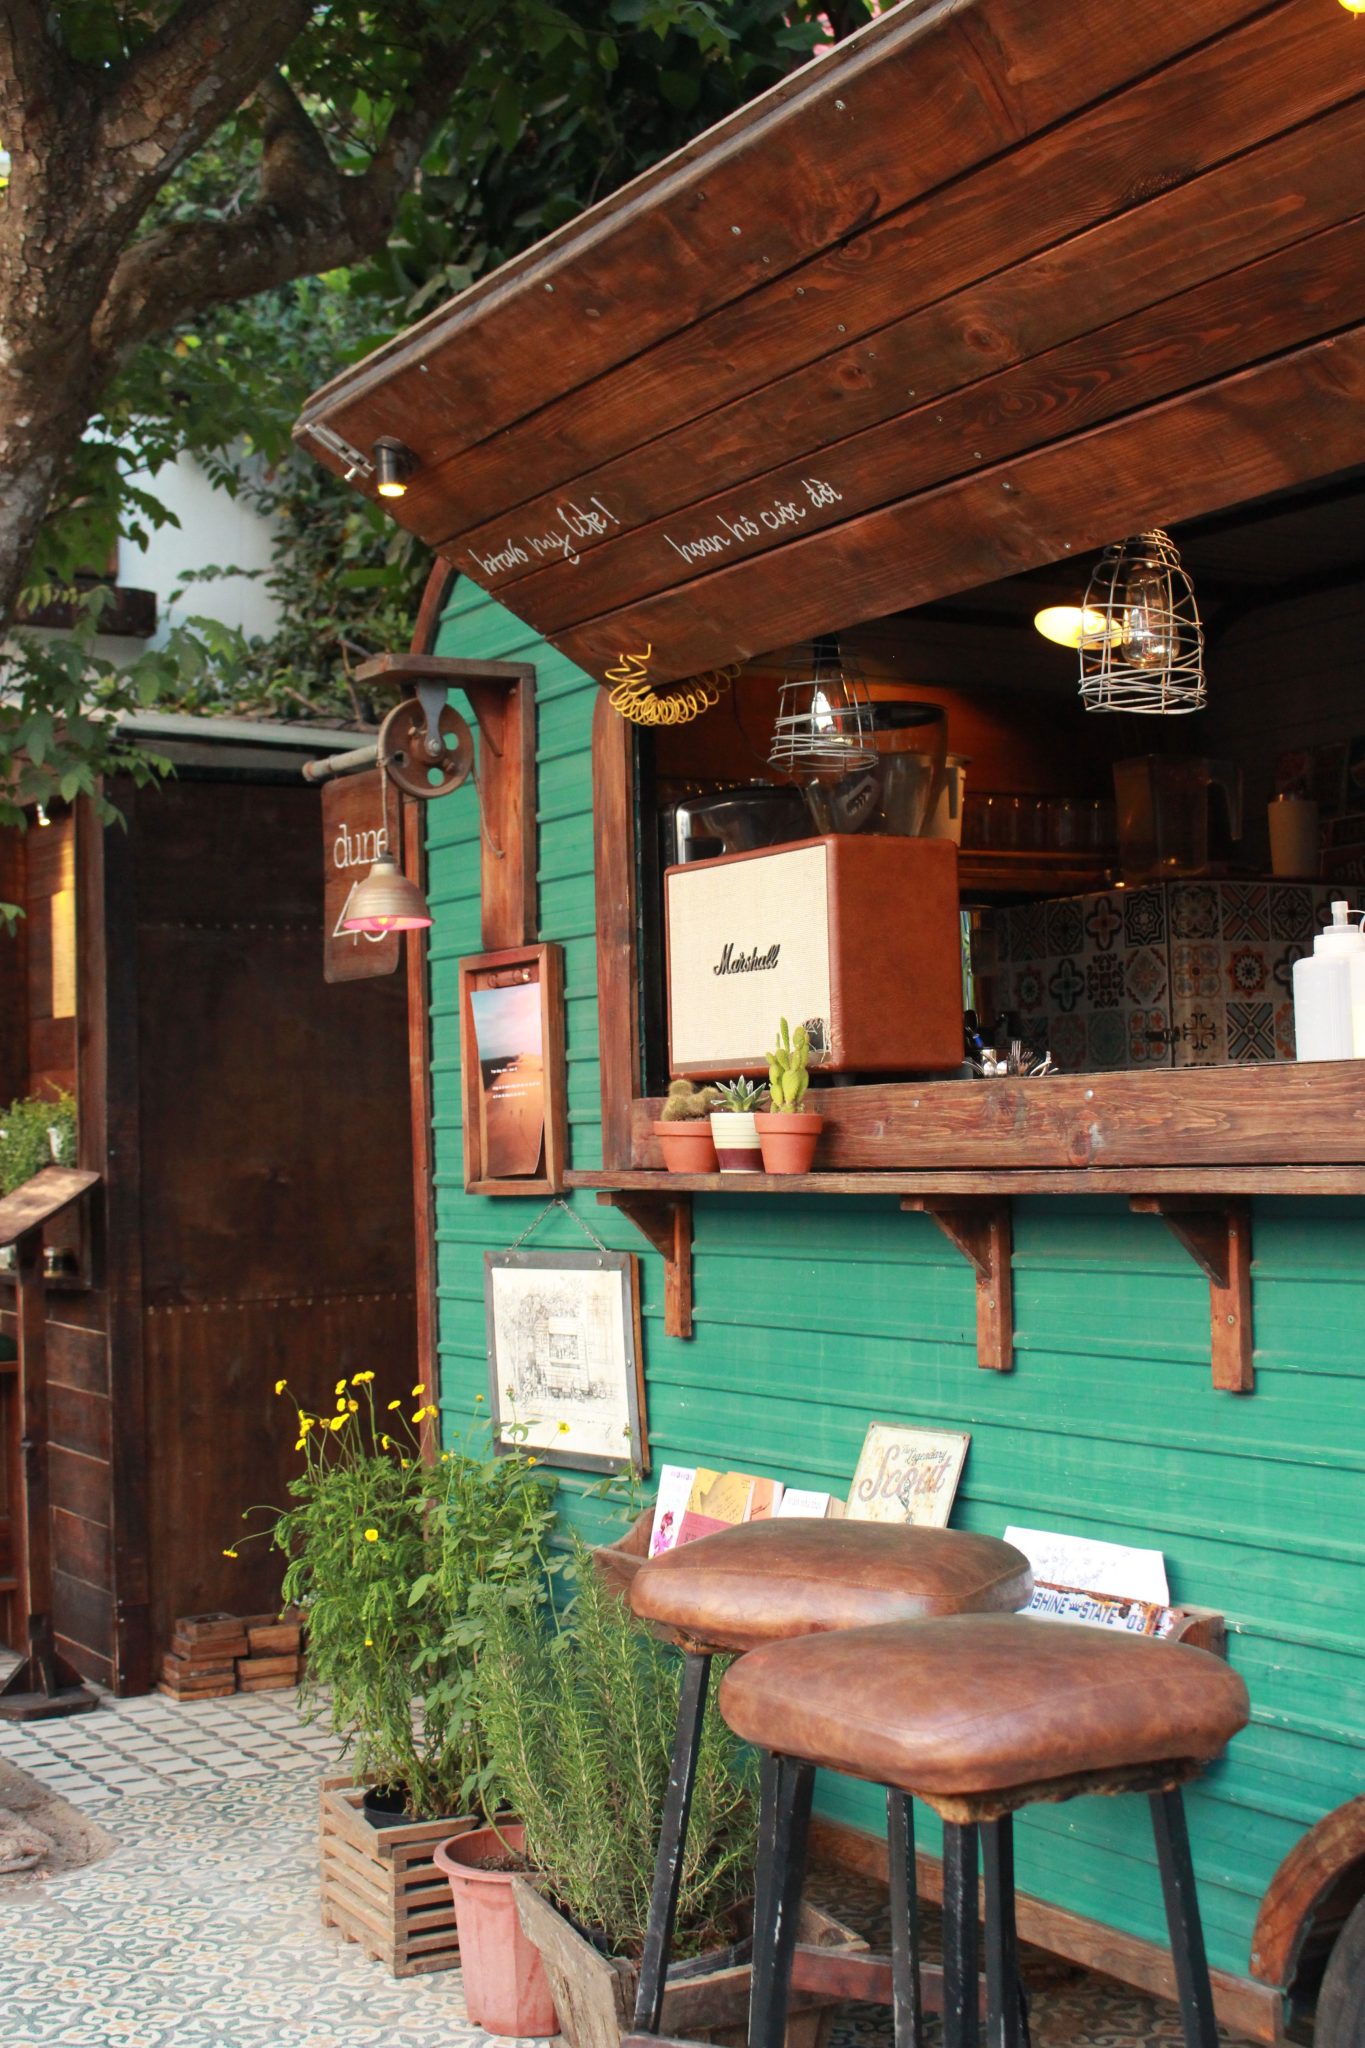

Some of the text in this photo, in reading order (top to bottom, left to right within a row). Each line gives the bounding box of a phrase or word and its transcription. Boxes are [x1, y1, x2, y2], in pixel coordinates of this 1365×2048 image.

[468, 539, 529, 576] bravo
[524, 530, 580, 565] my
[663, 533, 731, 564] hoan
[717, 515, 760, 542] hô
[760, 500, 806, 530] cuộc
[333, 823, 388, 869] dune
[713, 942, 781, 976] Marshall
[858, 1444, 952, 1502] Scout
[905, 1447, 949, 1466] Legendary
[1080, 1601, 1119, 1625] STATE
